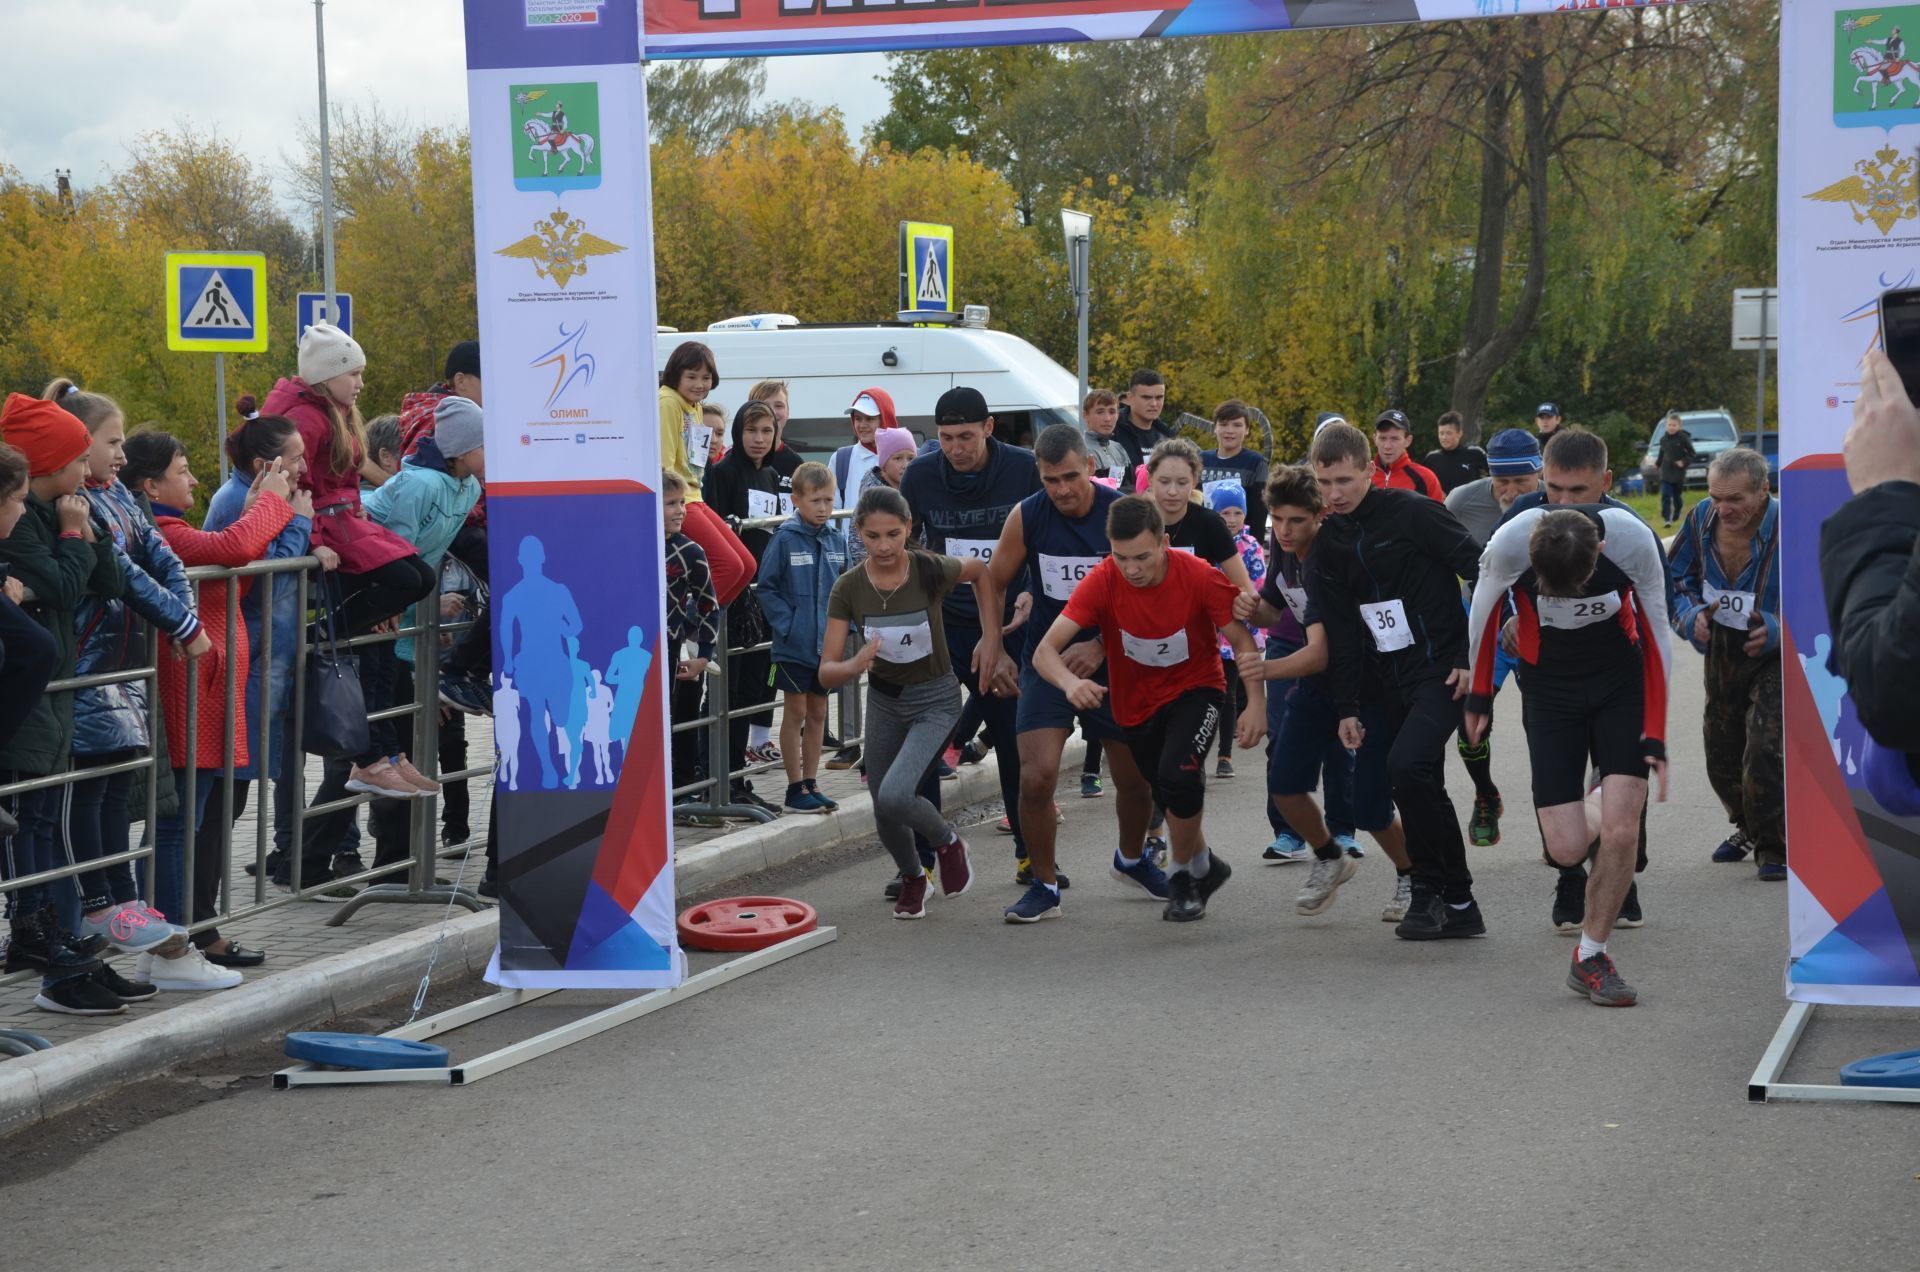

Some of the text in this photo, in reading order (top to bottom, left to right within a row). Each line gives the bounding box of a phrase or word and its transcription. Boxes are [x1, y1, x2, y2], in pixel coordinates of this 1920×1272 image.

[549, 408, 589, 419] ОЛИМП
[700, 433, 710, 449] 1
[763, 499, 775, 515] 11
[1573, 601, 1607, 617] 28
[1719, 594, 1744, 613] 90
[1375, 609, 1396, 630] 36
[900, 633, 913, 647] 4
[1156, 642, 1170, 655] 2
[1192, 703, 1219, 754] Reebok
